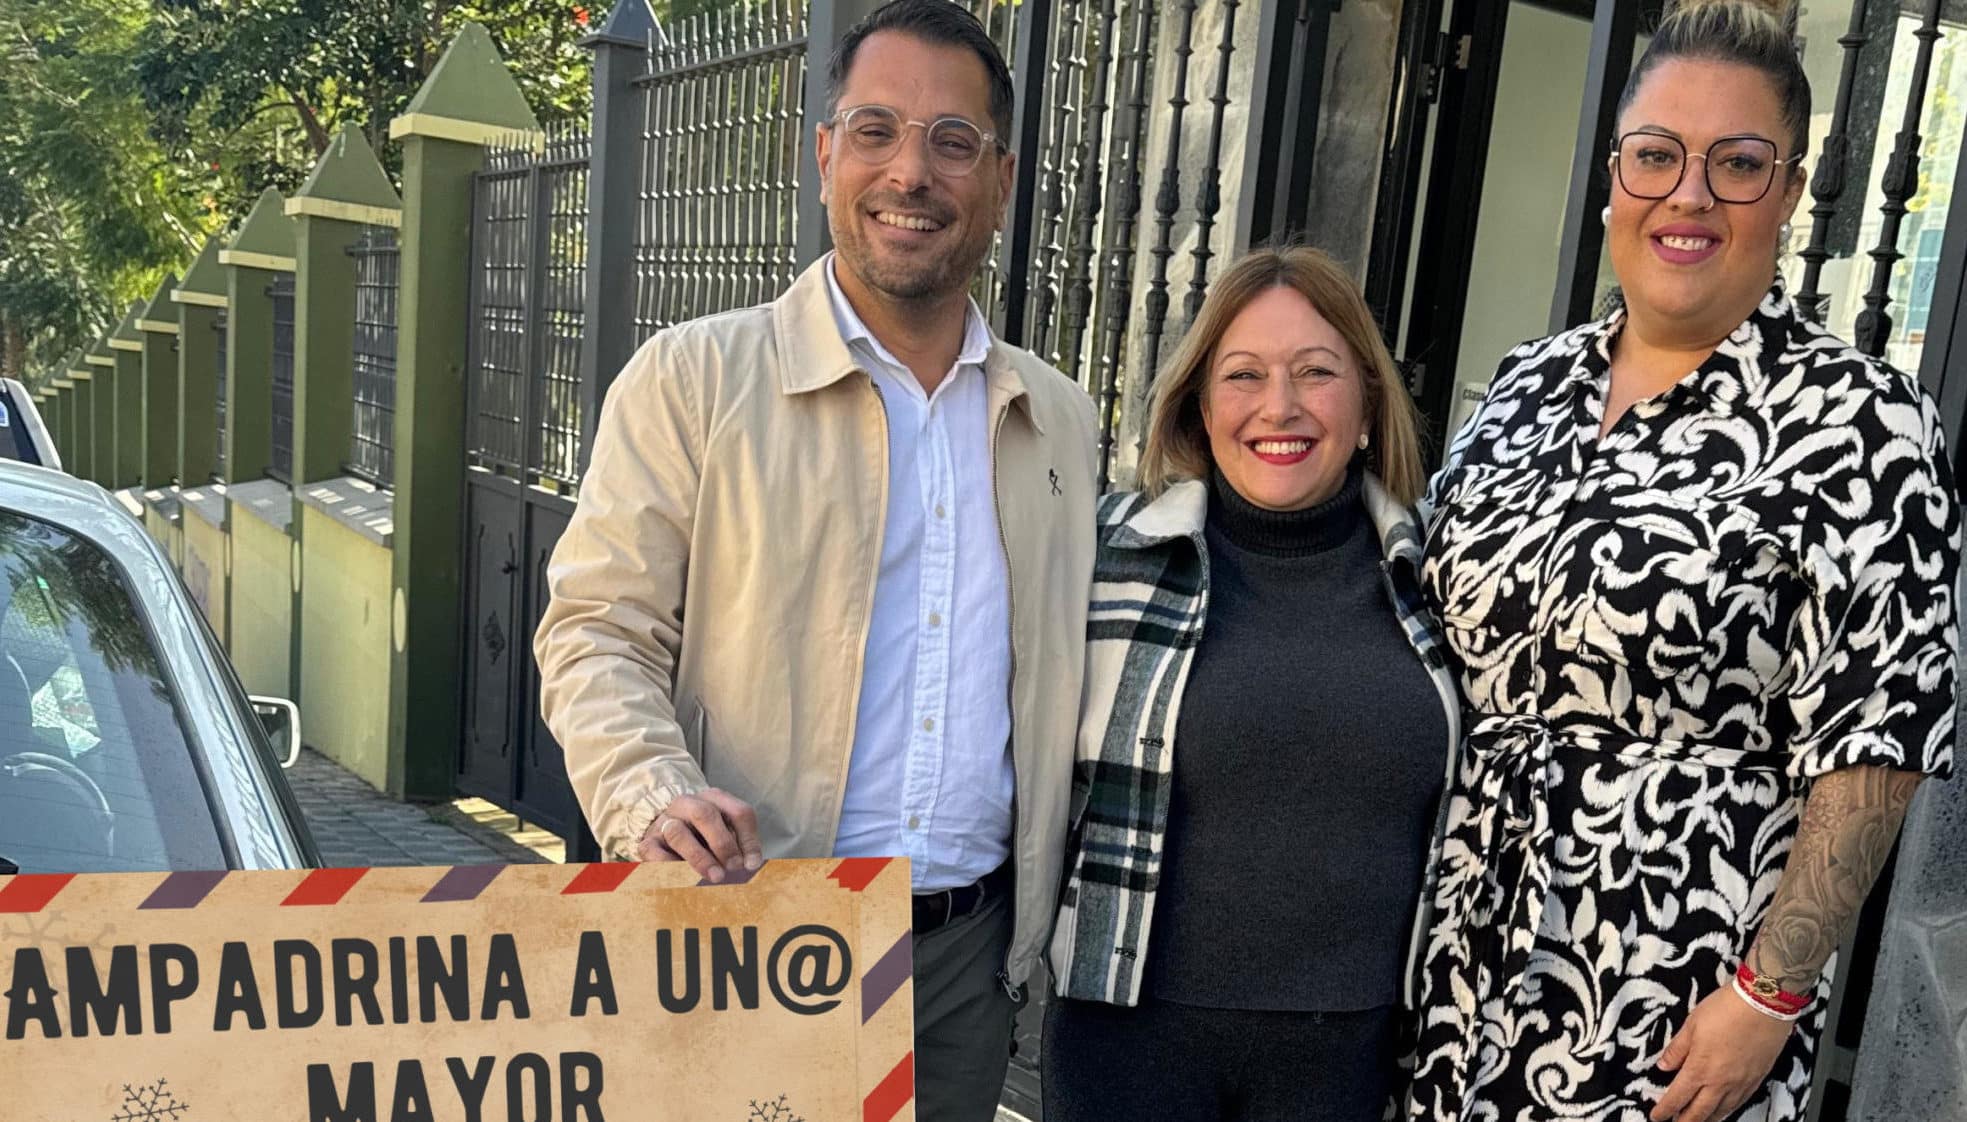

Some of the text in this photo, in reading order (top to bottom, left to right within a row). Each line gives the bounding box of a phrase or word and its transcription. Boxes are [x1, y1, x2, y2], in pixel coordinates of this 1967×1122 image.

[3, 924, 852, 1039] AMPADRINA A UN@
[307, 1051, 606, 1122] MAYOR
